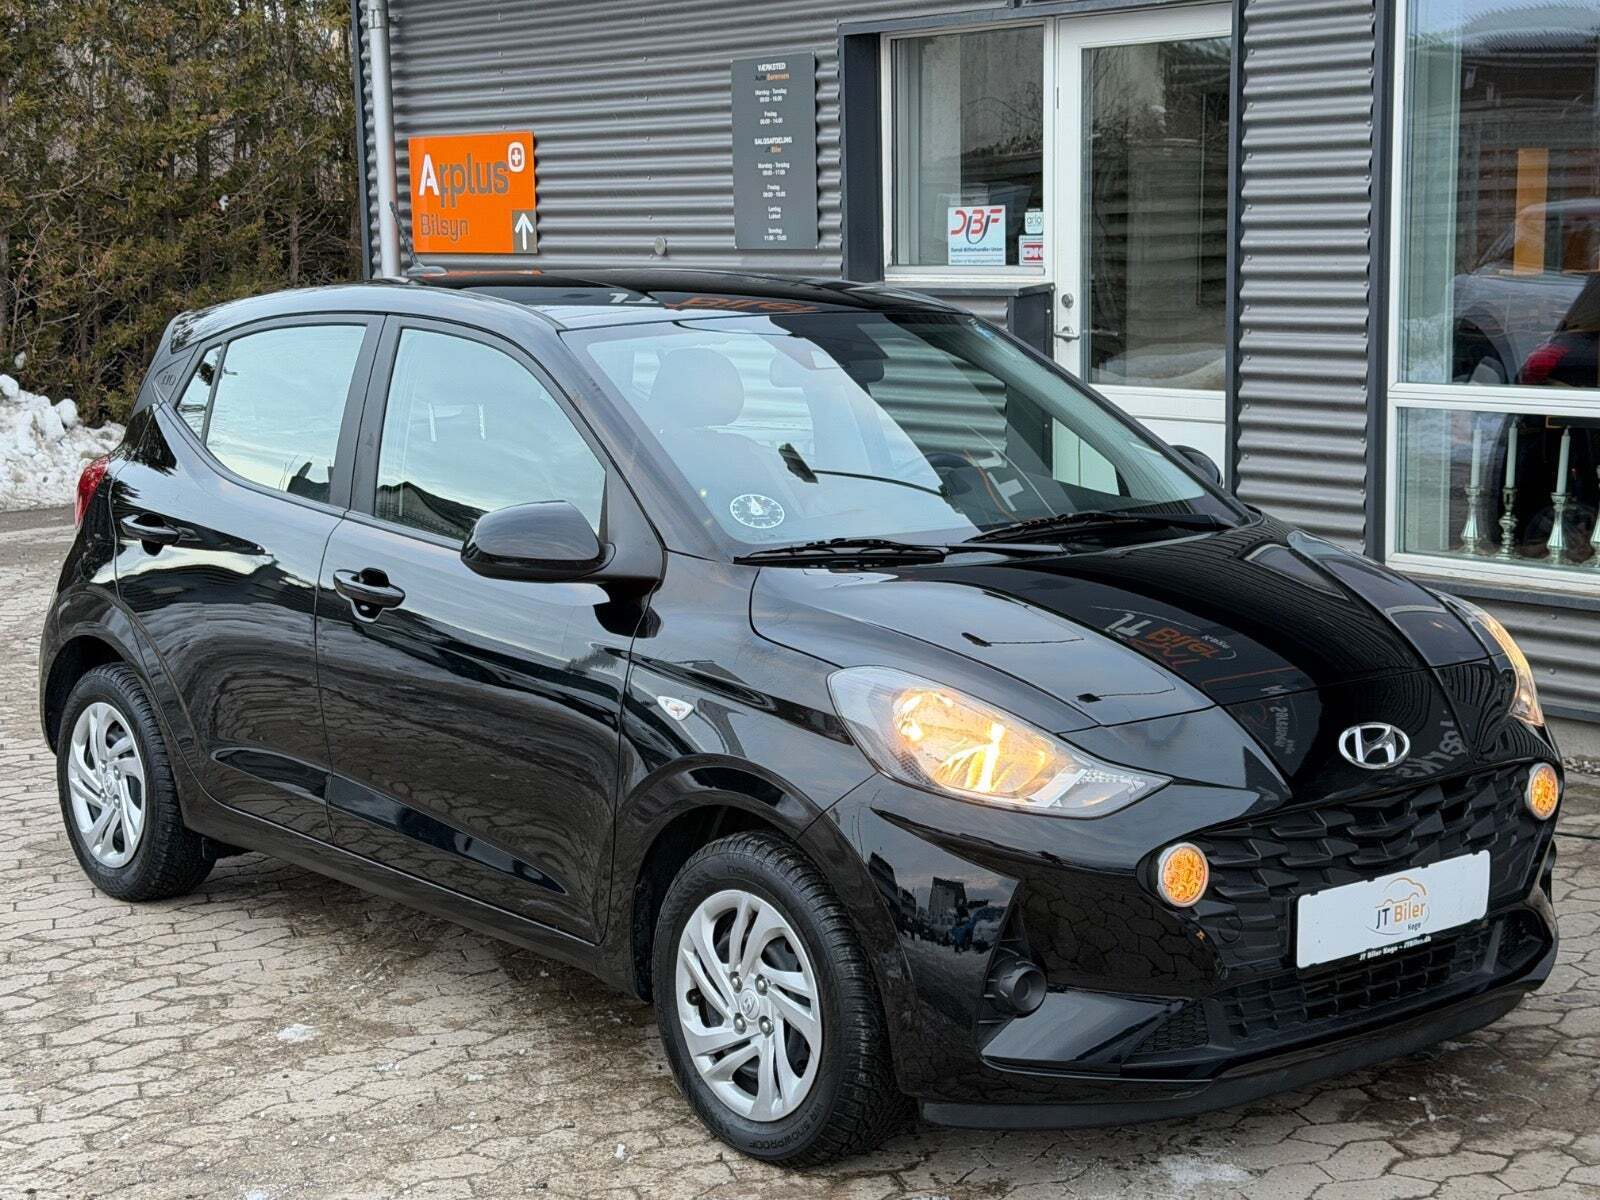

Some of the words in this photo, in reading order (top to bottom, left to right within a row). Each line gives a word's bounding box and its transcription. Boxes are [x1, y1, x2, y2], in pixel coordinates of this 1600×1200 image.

[421, 214, 468, 241] Bilsyn
[1376, 907, 1390, 929] JT
[1394, 901, 1426, 923] Biler
